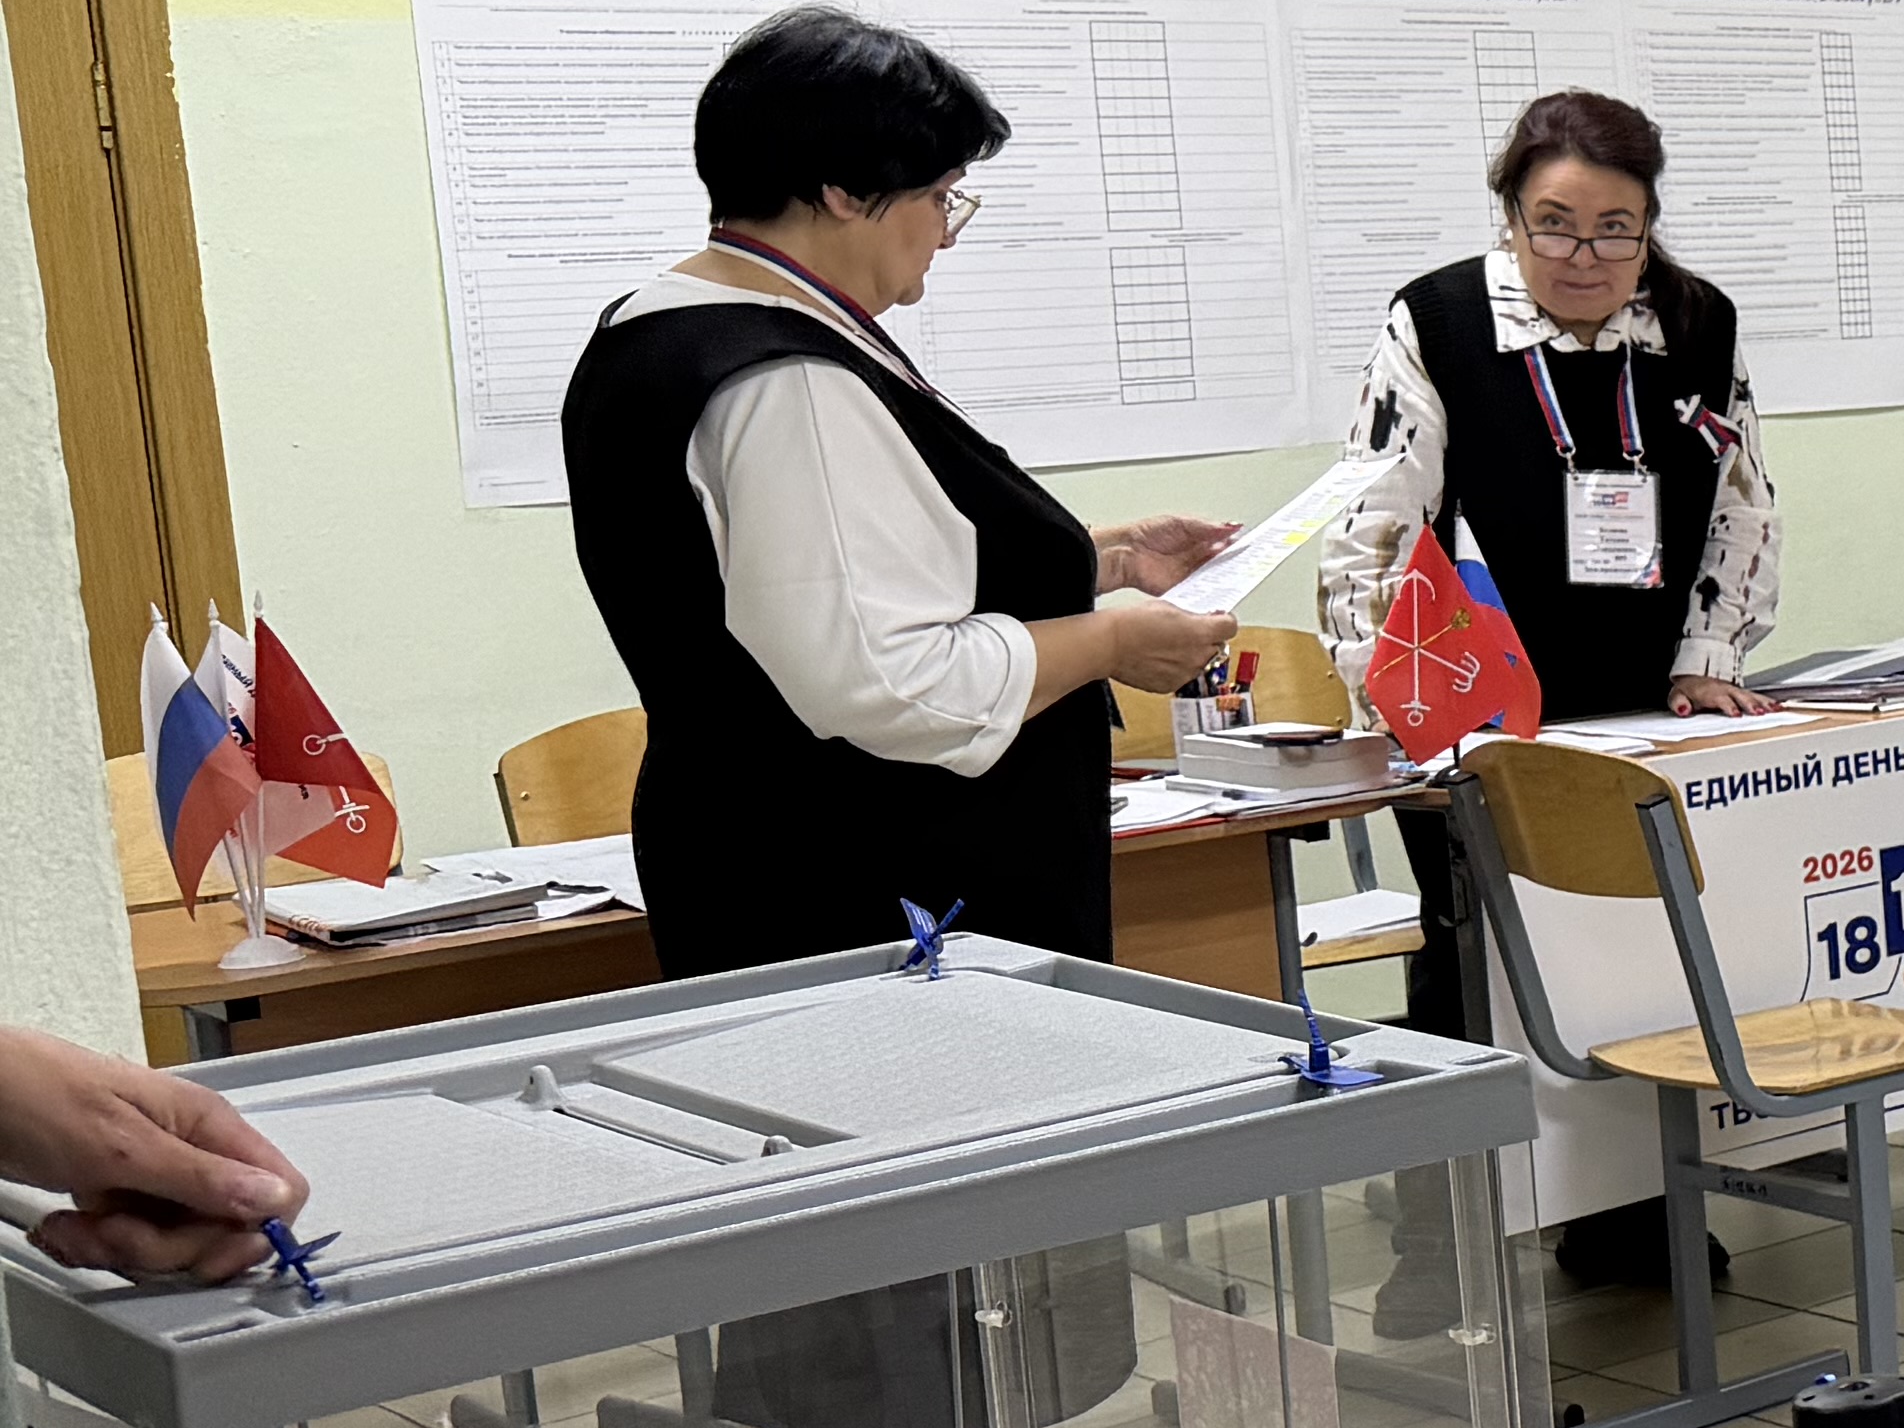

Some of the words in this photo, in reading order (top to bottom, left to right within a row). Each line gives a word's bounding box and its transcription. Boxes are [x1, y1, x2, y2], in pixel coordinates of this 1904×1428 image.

[1686, 755, 1823, 810] ЕДИНЫЙ
[1802, 846, 1875, 884] 2026
[1815, 915, 1881, 981] 18
